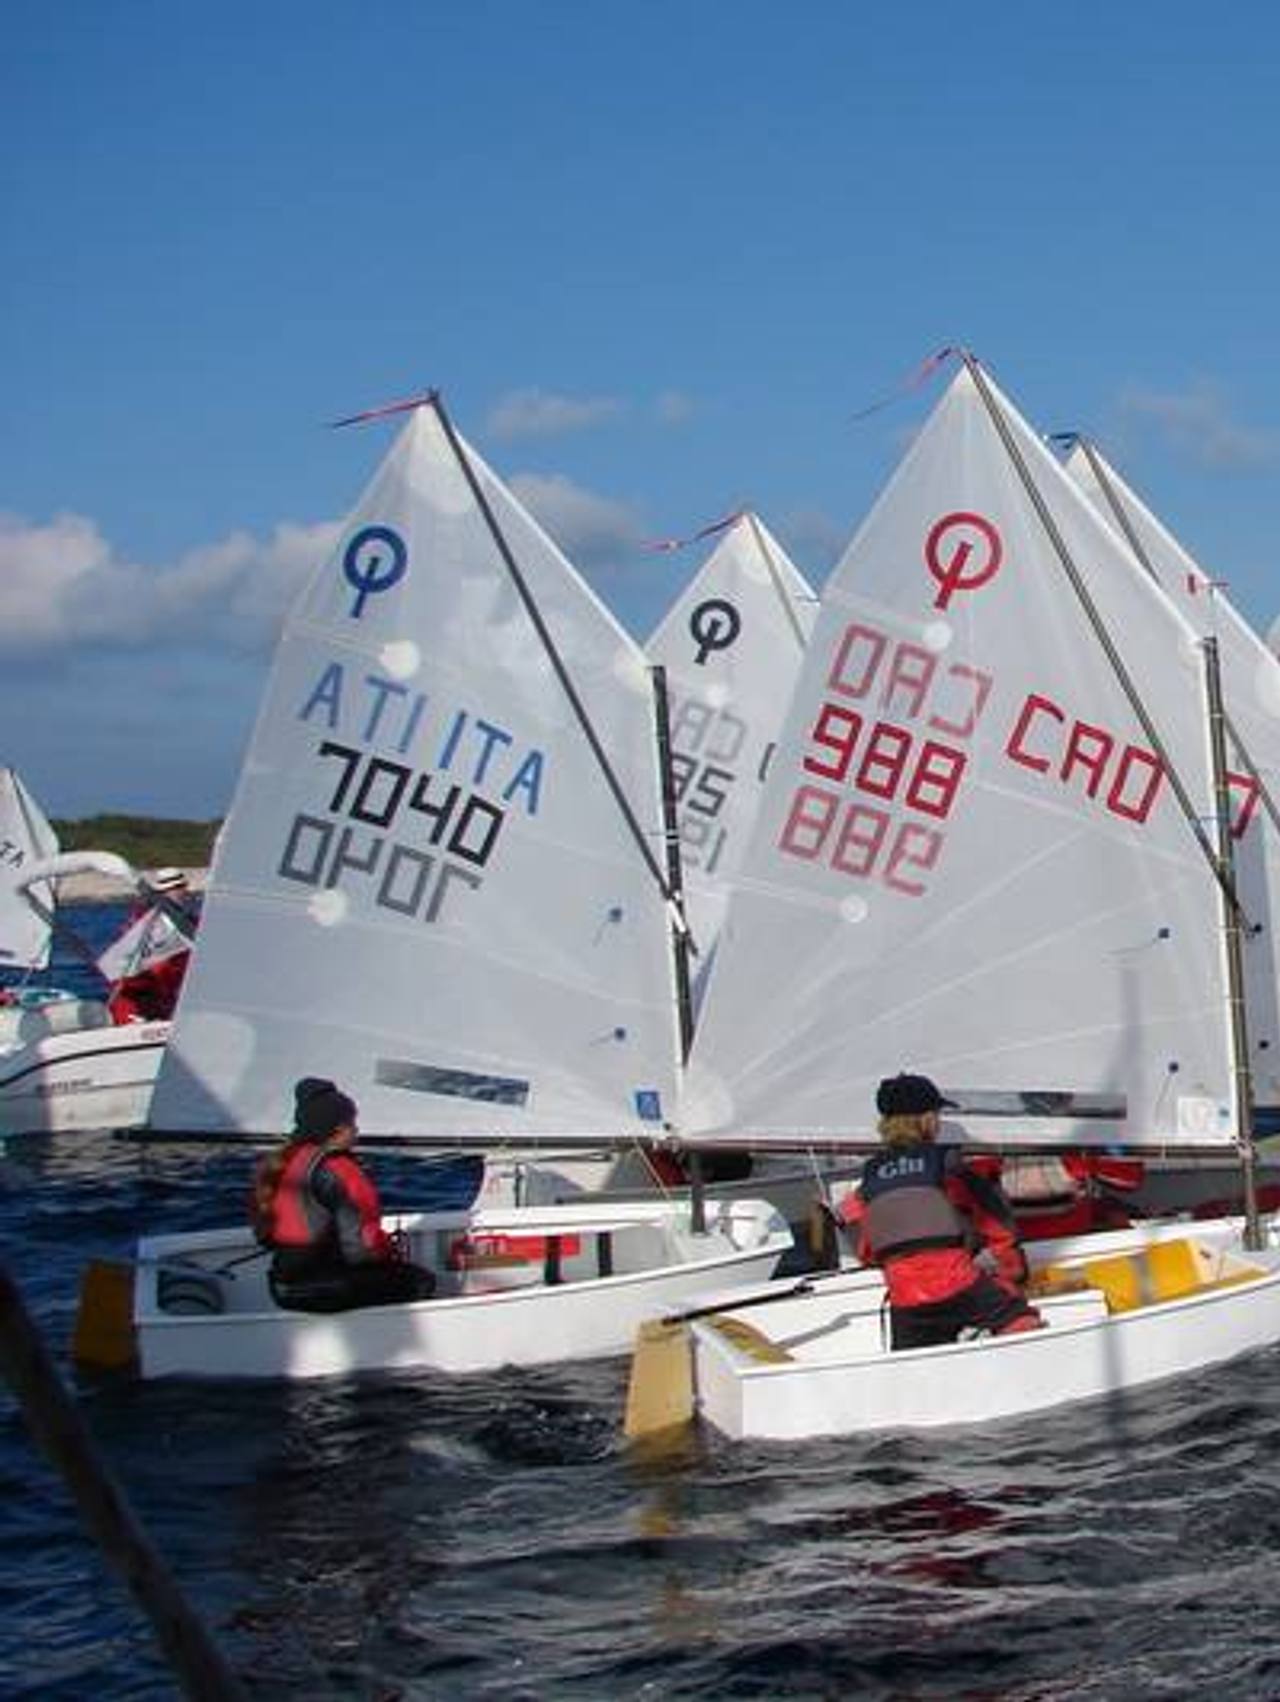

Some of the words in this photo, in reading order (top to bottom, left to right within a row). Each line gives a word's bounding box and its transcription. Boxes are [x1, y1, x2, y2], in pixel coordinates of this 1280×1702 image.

[318, 741, 505, 868] 7040
[438, 709, 544, 816] ITA
[803, 702, 968, 820] 988
